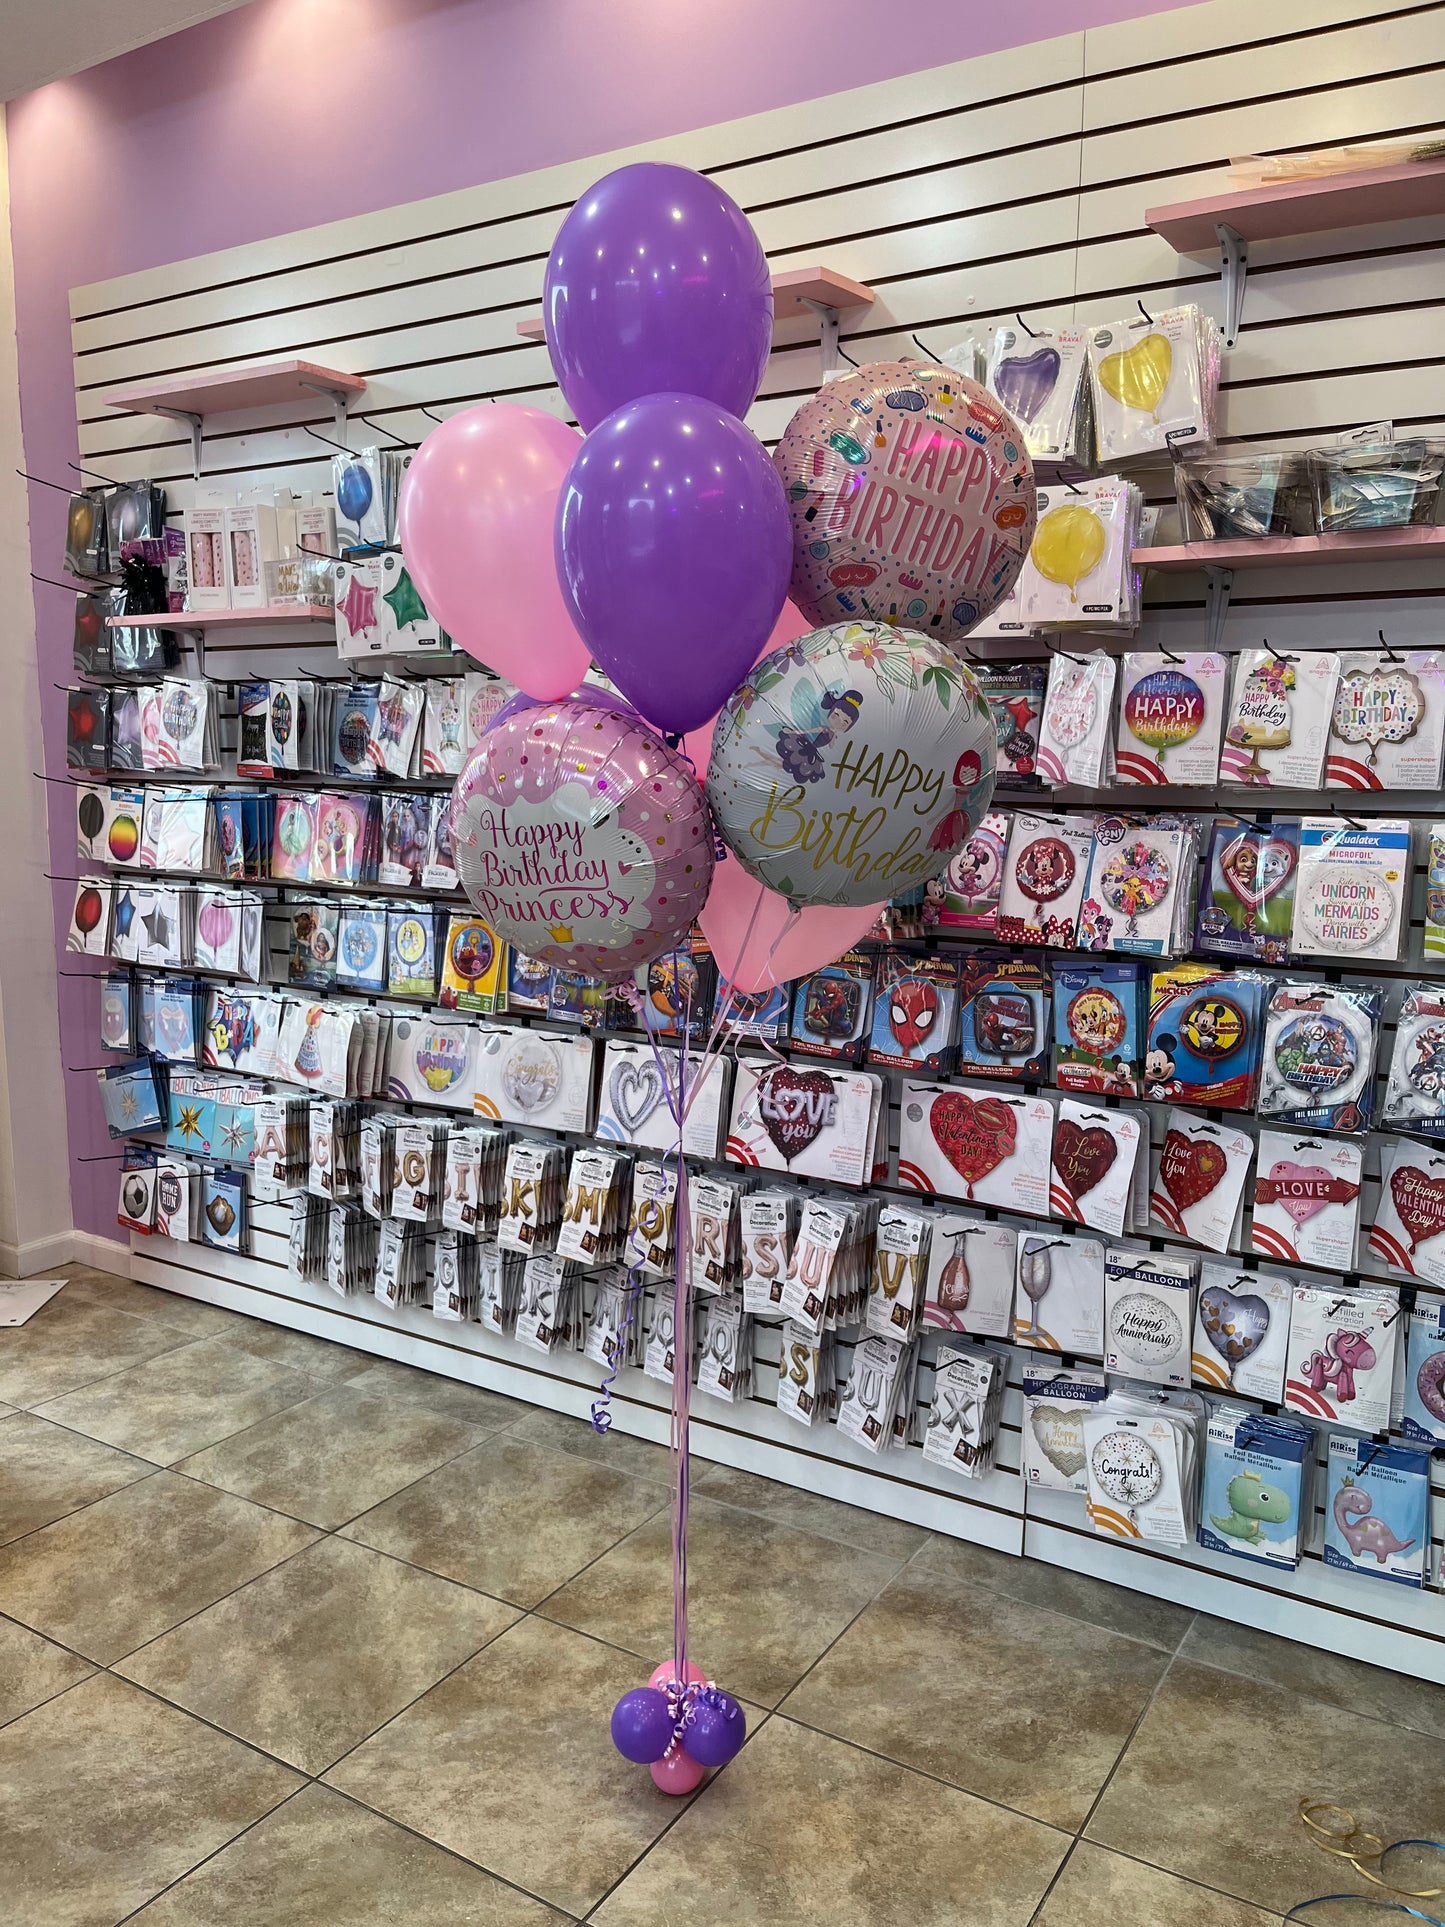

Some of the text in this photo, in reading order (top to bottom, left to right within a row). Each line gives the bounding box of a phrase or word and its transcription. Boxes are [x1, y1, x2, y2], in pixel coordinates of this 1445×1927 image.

[886, 418, 1007, 515] HAPPY
[826, 472, 1008, 590] BIRTHDAY
[481, 700, 501, 712] HAPPY
[1245, 693, 1269, 703] HAPPY
[1354, 690, 1397, 707] HAPPY
[1239, 702, 1286, 726] Birthday
[1342, 707, 1408, 725] BIRTHDAY
[1135, 717, 1190, 736] Birthday
[480, 808, 586, 856] Happy
[750, 780, 937, 882] Birthday
[1097, 828, 1125, 843] PONY
[480, 850, 610, 888] Birthday
[1322, 885, 1375, 899] UNICORN
[478, 889, 635, 925] Princess
[1314, 904, 1380, 920] MERMAIDS
[1322, 925, 1368, 940] FAIRIES
[1063, 973, 1087, 986] Disney
[1154, 986, 1193, 996] MICKEY
[424, 1038, 461, 1053] HAPPY
[807, 1044, 832, 1052] BALLOON
[887, 1056, 914, 1064] BALLOON
[505, 1058, 559, 1085] Congrats
[1286, 1071, 1337, 1085] BIRTHDAY
[1297, 1064, 1341, 1077] HAPPY
[939, 1110, 968, 1124] HAPPY
[782, 1123, 816, 1145] you
[961, 1144, 984, 1158] DAY!
[1073, 1137, 1100, 1158] Love
[1168, 1142, 1192, 1160] Love
[403, 1150, 425, 1188] G
[1068, 1157, 1092, 1179] You
[1166, 1160, 1186, 1176] You
[1281, 1182, 1325, 1196] LOVE
[1404, 1177, 1444, 1201] Happy
[162, 1194, 177, 1209] RUN
[509, 1178, 534, 1219] K
[572, 1184, 601, 1226] M
[1408, 1210, 1435, 1228] Day!
[695, 1213, 722, 1259] R
[754, 1234, 780, 1280] S
[801, 1243, 824, 1290] U
[878, 1251, 908, 1301] V
[1135, 1271, 1182, 1287] BALLOON
[1123, 1311, 1167, 1331] Happy
[1114, 1323, 1175, 1348] Anniversary
[790, 1342, 811, 1386] S
[858, 1368, 883, 1412] U
[1043, 1388, 1086, 1400] BALLOON
[941, 1388, 975, 1437] X
[1053, 1425, 1078, 1441] Happy
[1208, 1429, 1234, 1440] AiRise
[1406, 1423, 1418, 1431] Size
[1330, 1441, 1357, 1453] AiRise
[1225, 1452, 1245, 1462] Ballon
[1234, 1449, 1273, 1463] Foil Balloon
[1101, 1458, 1153, 1484] Congrats!
[1372, 1466, 1398, 1476] Balloon
[1327, 1551, 1338, 1559] Size
